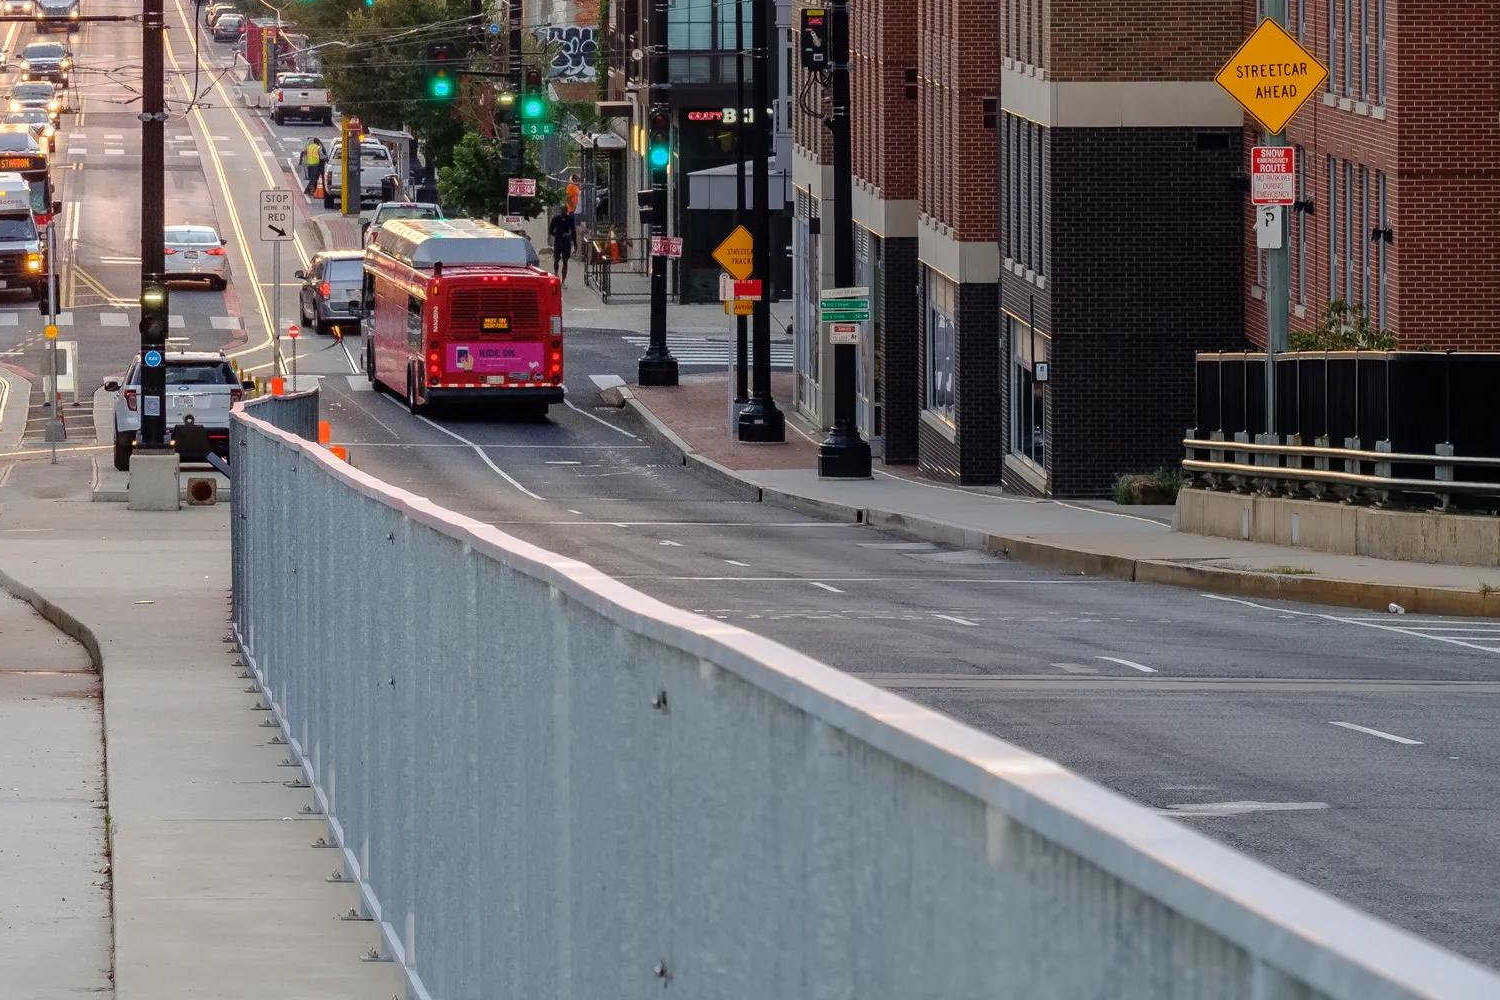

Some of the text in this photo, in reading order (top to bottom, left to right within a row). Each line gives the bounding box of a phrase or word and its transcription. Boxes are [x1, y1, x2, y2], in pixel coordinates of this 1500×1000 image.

[1236, 62, 1308, 79] STREETCAR
[1255, 84, 1297, 99] AHEAD
[530, 125, 537, 134] 3
[1260, 149, 1285, 158] SNOW
[1, 158, 30, 169] STATION
[1260, 163, 1287, 173] ROUTE
[1262, 182, 1284, 190] DURING
[265, 194, 289, 203] STOP
[1256, 190, 1290, 199] EMERGENCY
[268, 213, 286, 222] RED
[727, 248, 753, 256] STREETC
